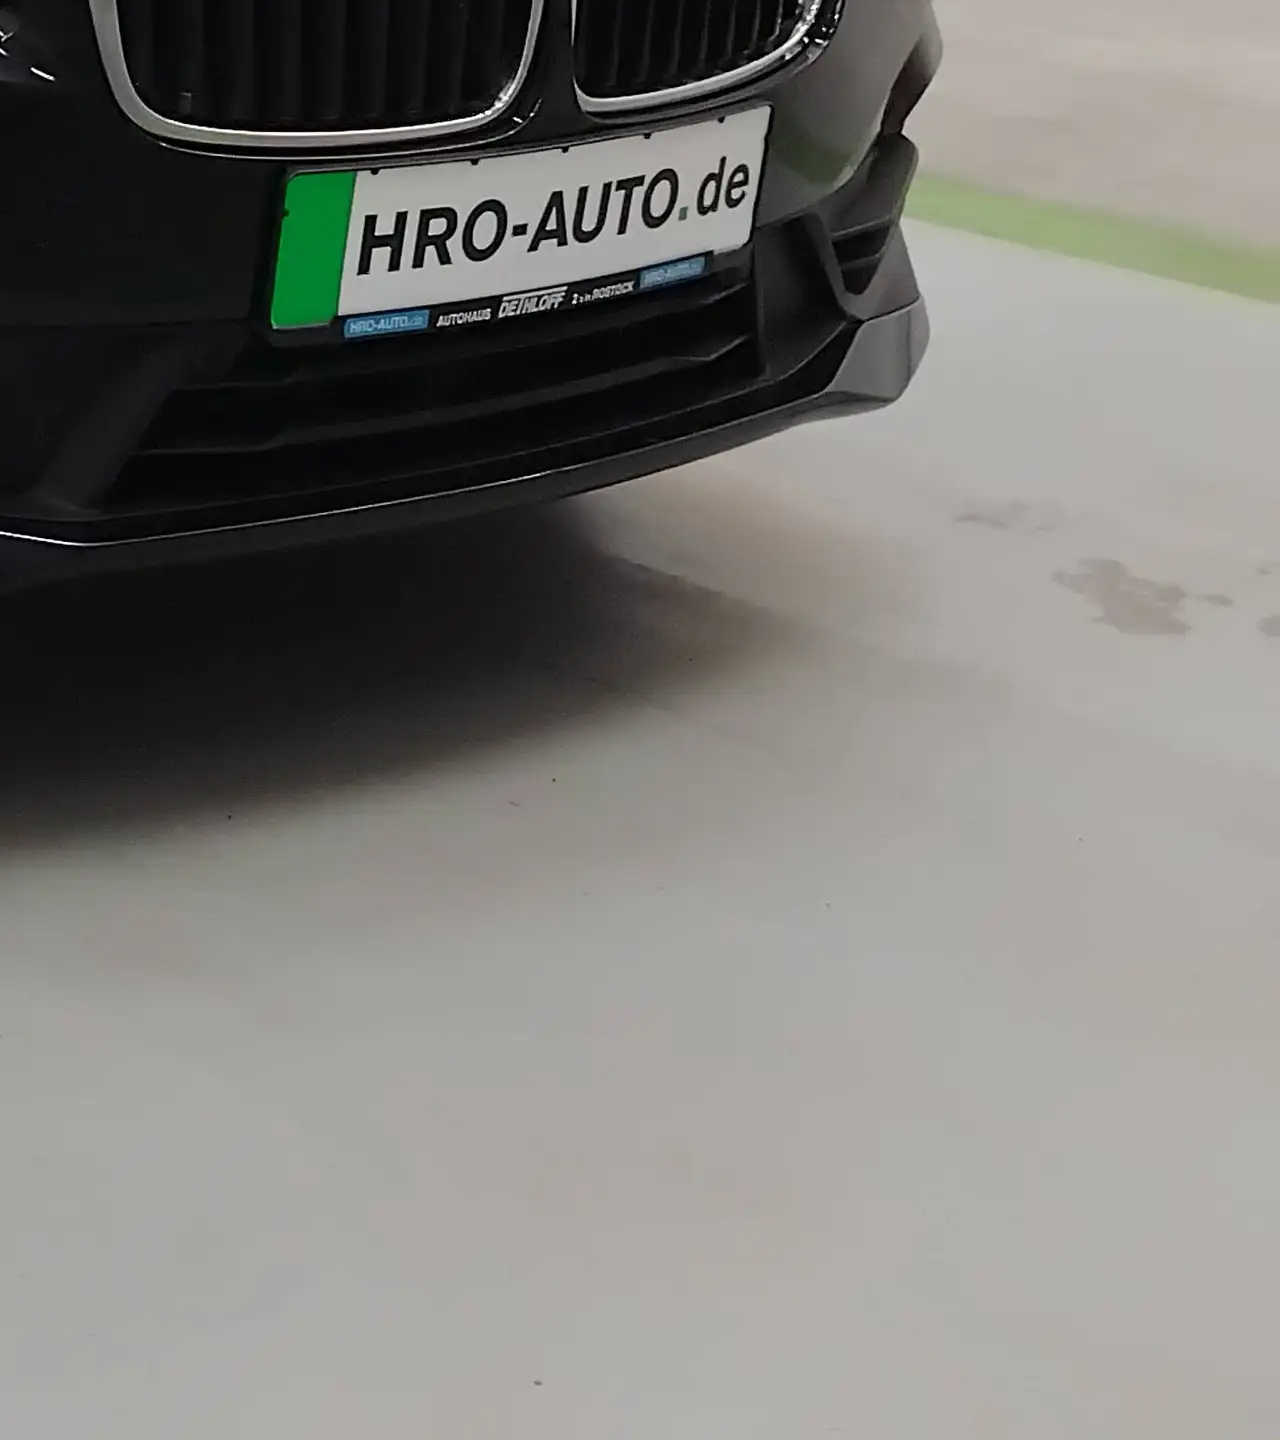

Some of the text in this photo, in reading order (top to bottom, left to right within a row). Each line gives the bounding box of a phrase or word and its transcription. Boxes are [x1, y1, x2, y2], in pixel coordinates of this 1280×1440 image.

[357, 156, 750, 276] HRO-AUTO.de
[436, 309, 492, 327] AUTOHAUS
[498, 286, 568, 319] DETHLOFF
